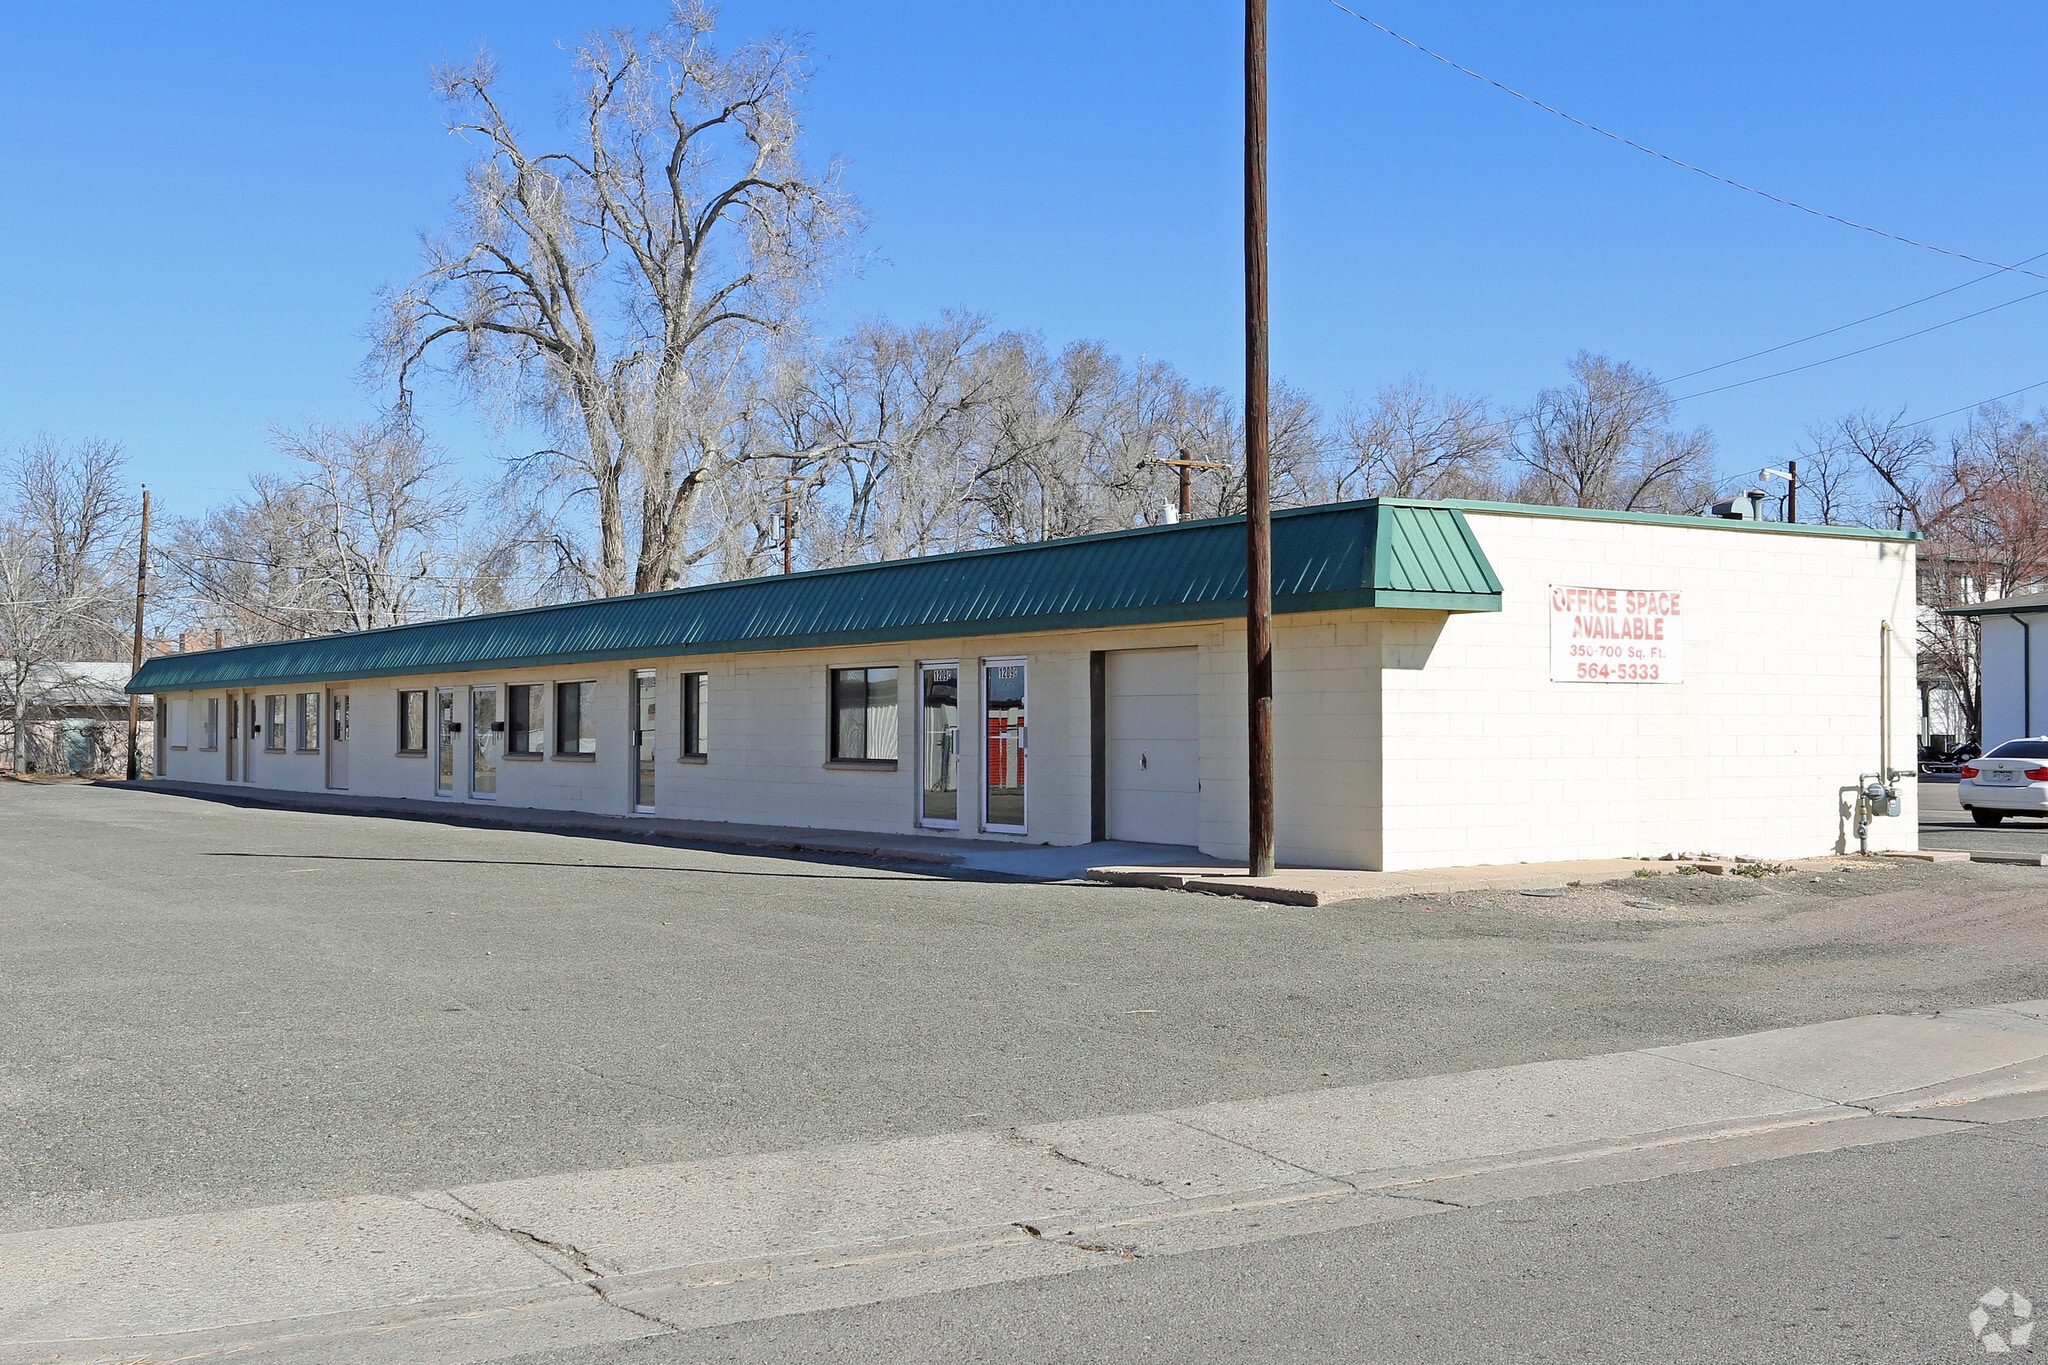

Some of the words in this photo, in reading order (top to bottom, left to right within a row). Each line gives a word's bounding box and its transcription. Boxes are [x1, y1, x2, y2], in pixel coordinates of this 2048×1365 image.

[1552, 588, 1618, 613] OFFICE
[1626, 590, 1681, 616] SPACE
[1572, 615, 1664, 641] AVAILABLE
[1569, 644, 1622, 658] 350-700
[1628, 646, 1646, 660] Sq.
[1577, 662, 1660, 680] 564-5333
